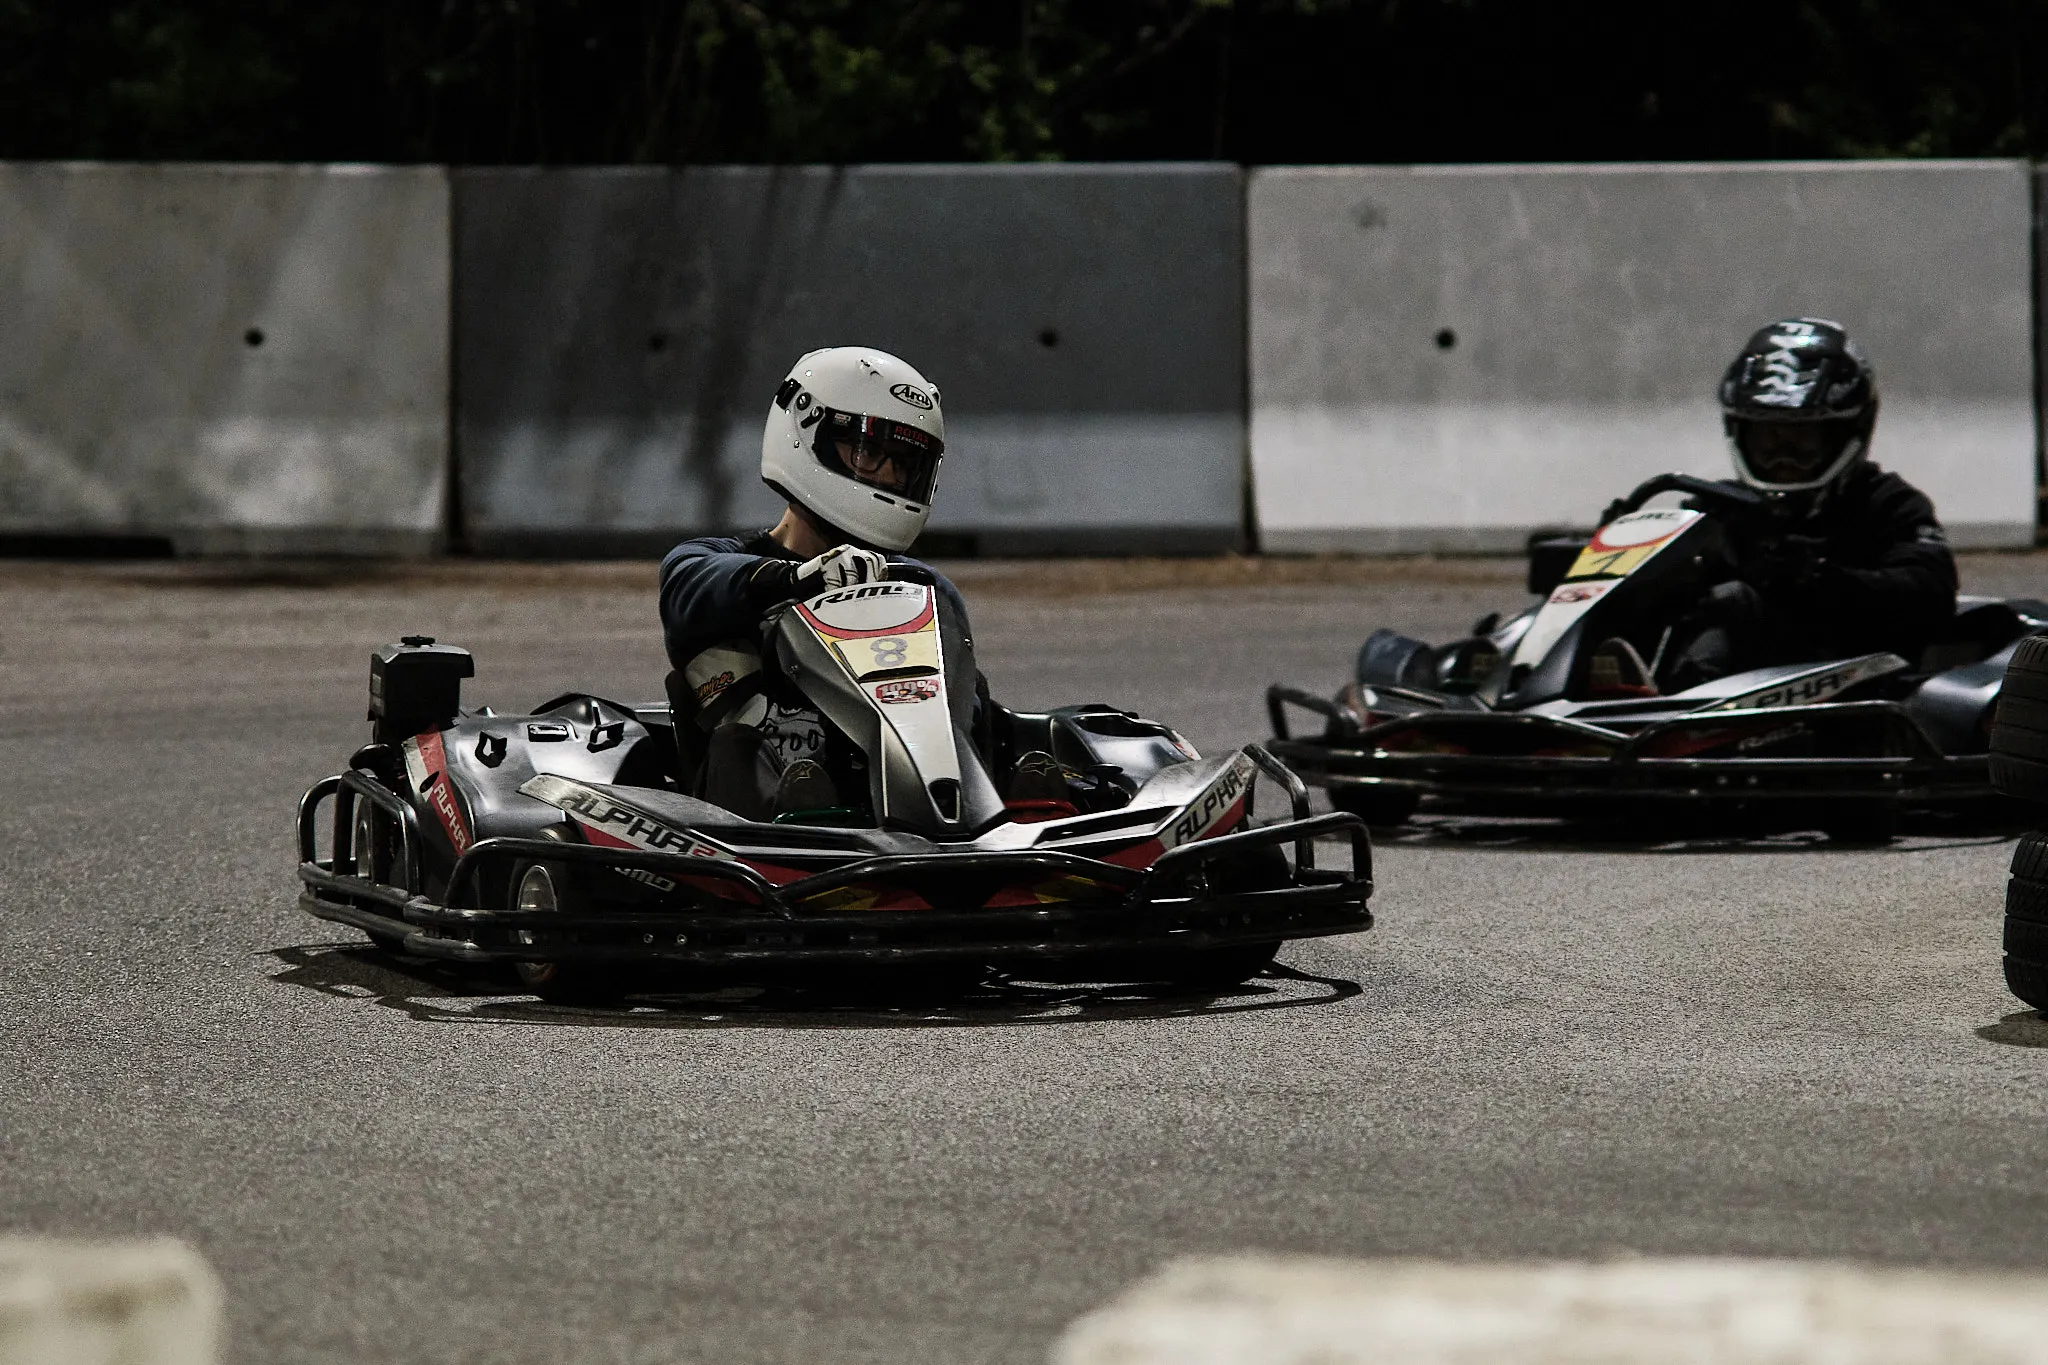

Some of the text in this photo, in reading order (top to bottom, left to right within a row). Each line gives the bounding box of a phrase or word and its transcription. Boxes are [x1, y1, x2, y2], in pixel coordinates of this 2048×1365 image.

[894, 385, 930, 406] Arai
[869, 637, 908, 668] 8
[433, 782, 467, 850] ALPHA
[560, 791, 695, 853] ALPHA
[1175, 769, 1243, 846] ALPHA
